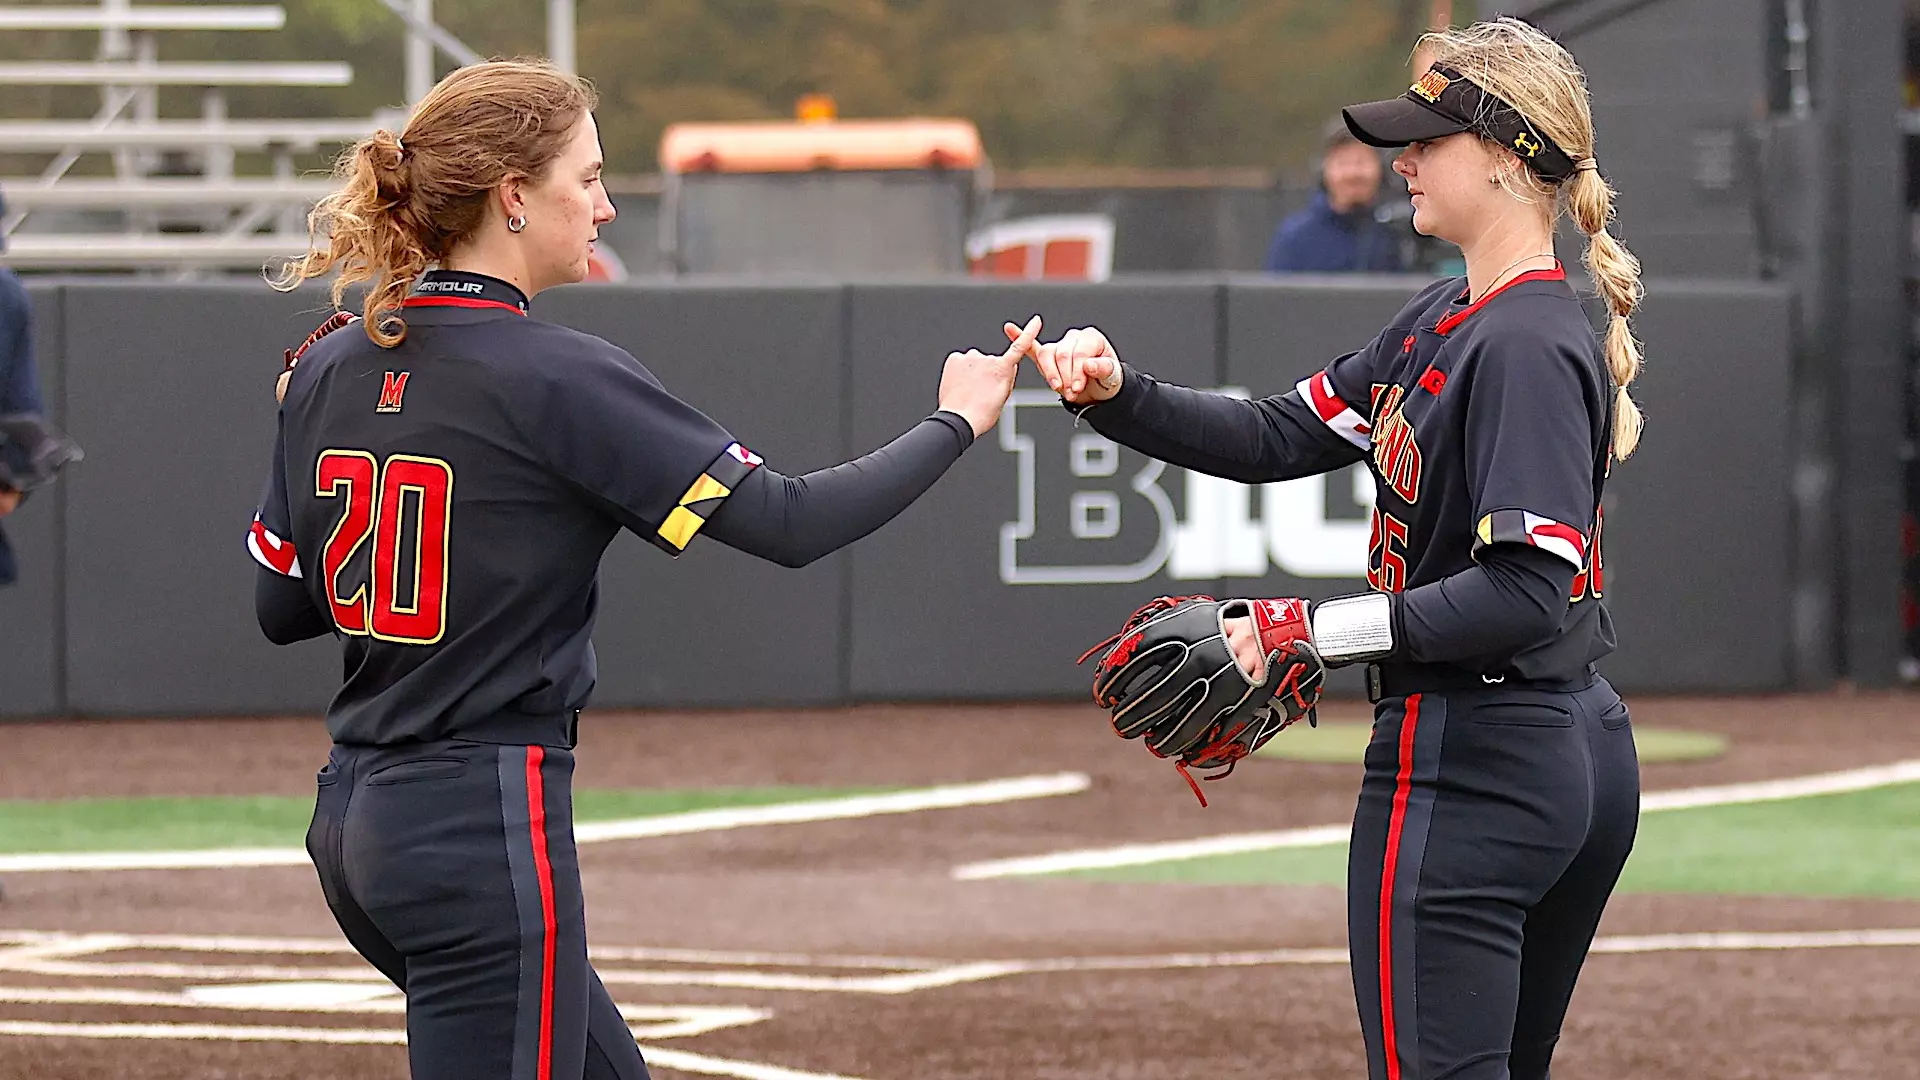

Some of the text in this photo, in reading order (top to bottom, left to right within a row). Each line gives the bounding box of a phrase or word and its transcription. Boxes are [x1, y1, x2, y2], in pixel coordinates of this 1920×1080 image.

[417, 281, 484, 294] ARMOUR
[377, 371, 410, 407] M
[316, 449, 454, 645] 20
